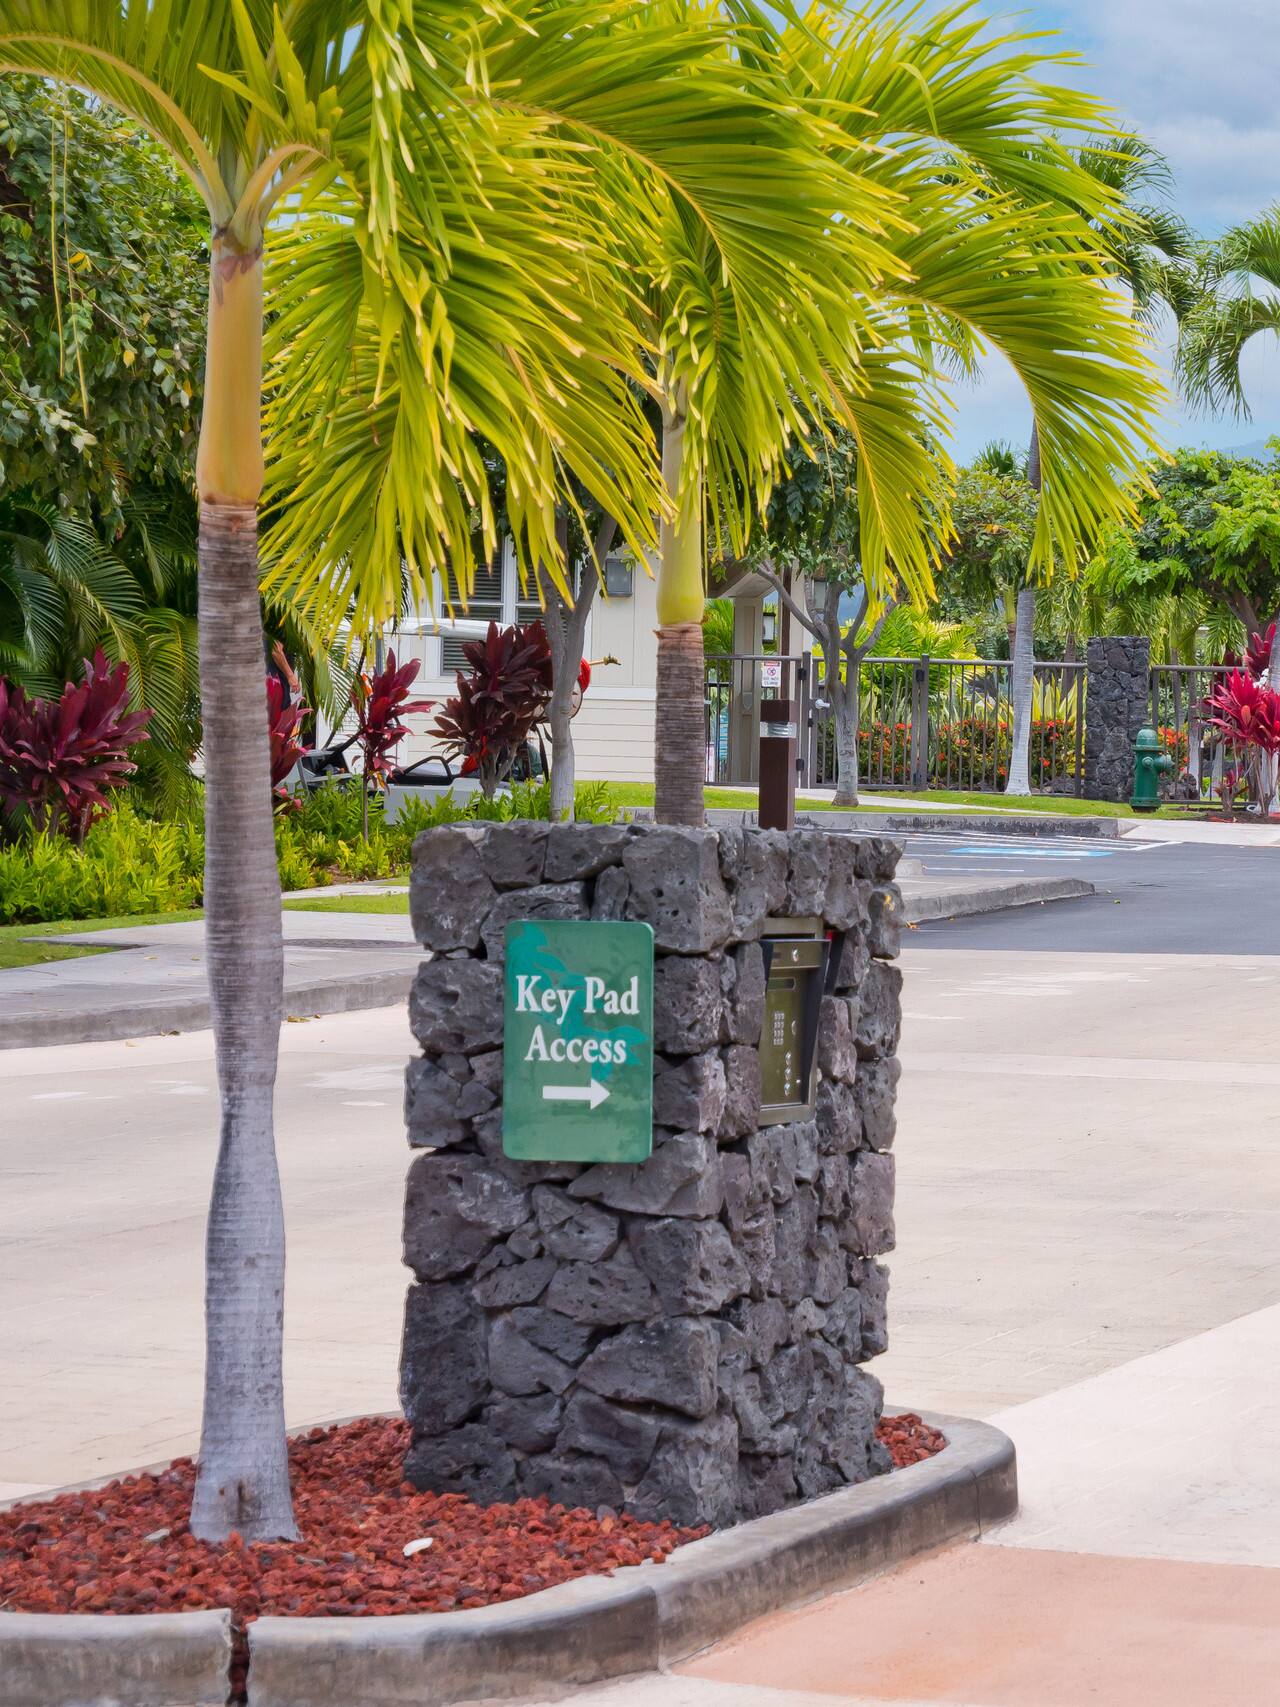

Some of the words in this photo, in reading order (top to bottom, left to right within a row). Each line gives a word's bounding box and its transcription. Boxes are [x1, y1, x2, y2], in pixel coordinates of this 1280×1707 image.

[515, 975, 576, 1025] Key
[583, 975, 640, 1015] Pad
[524, 1024, 627, 1064] Access
